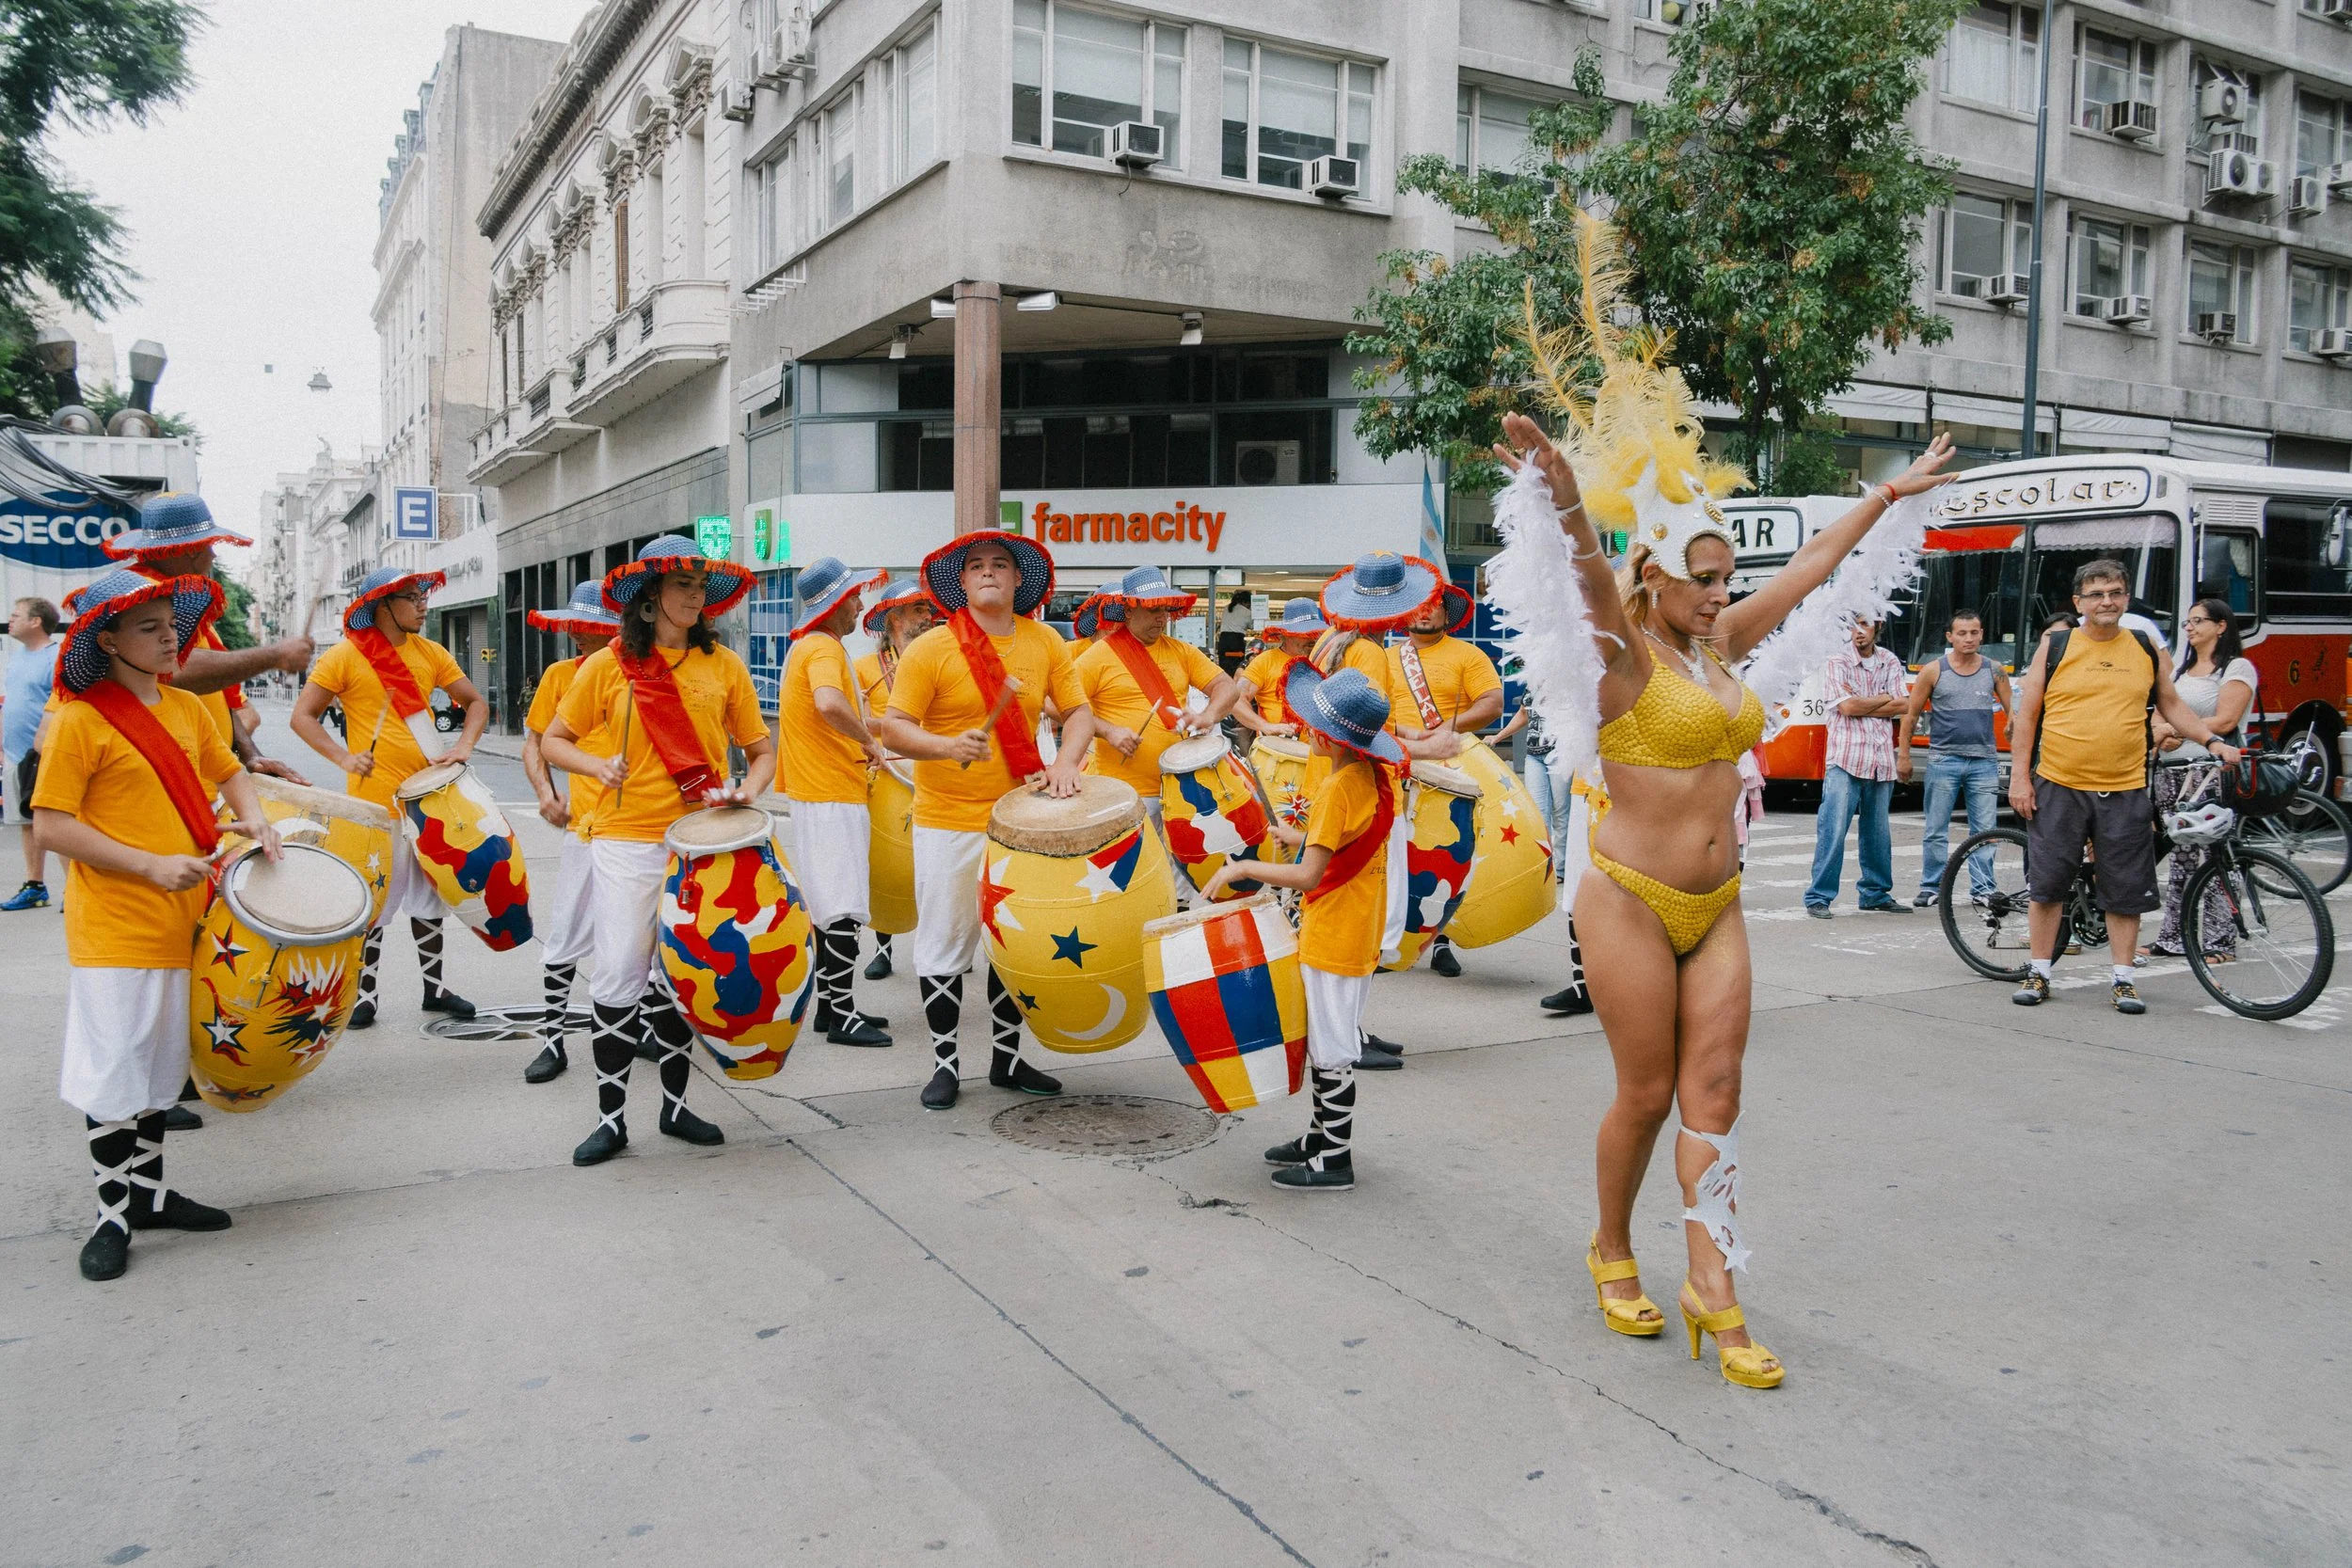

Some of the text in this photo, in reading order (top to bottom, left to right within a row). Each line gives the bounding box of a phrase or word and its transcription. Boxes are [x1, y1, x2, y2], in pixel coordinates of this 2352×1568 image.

[0, 514, 130, 546] SECCO
[403, 497, 427, 531] E
[1032, 501, 1227, 552] farmacity
[2288, 659, 2300, 686] 6
